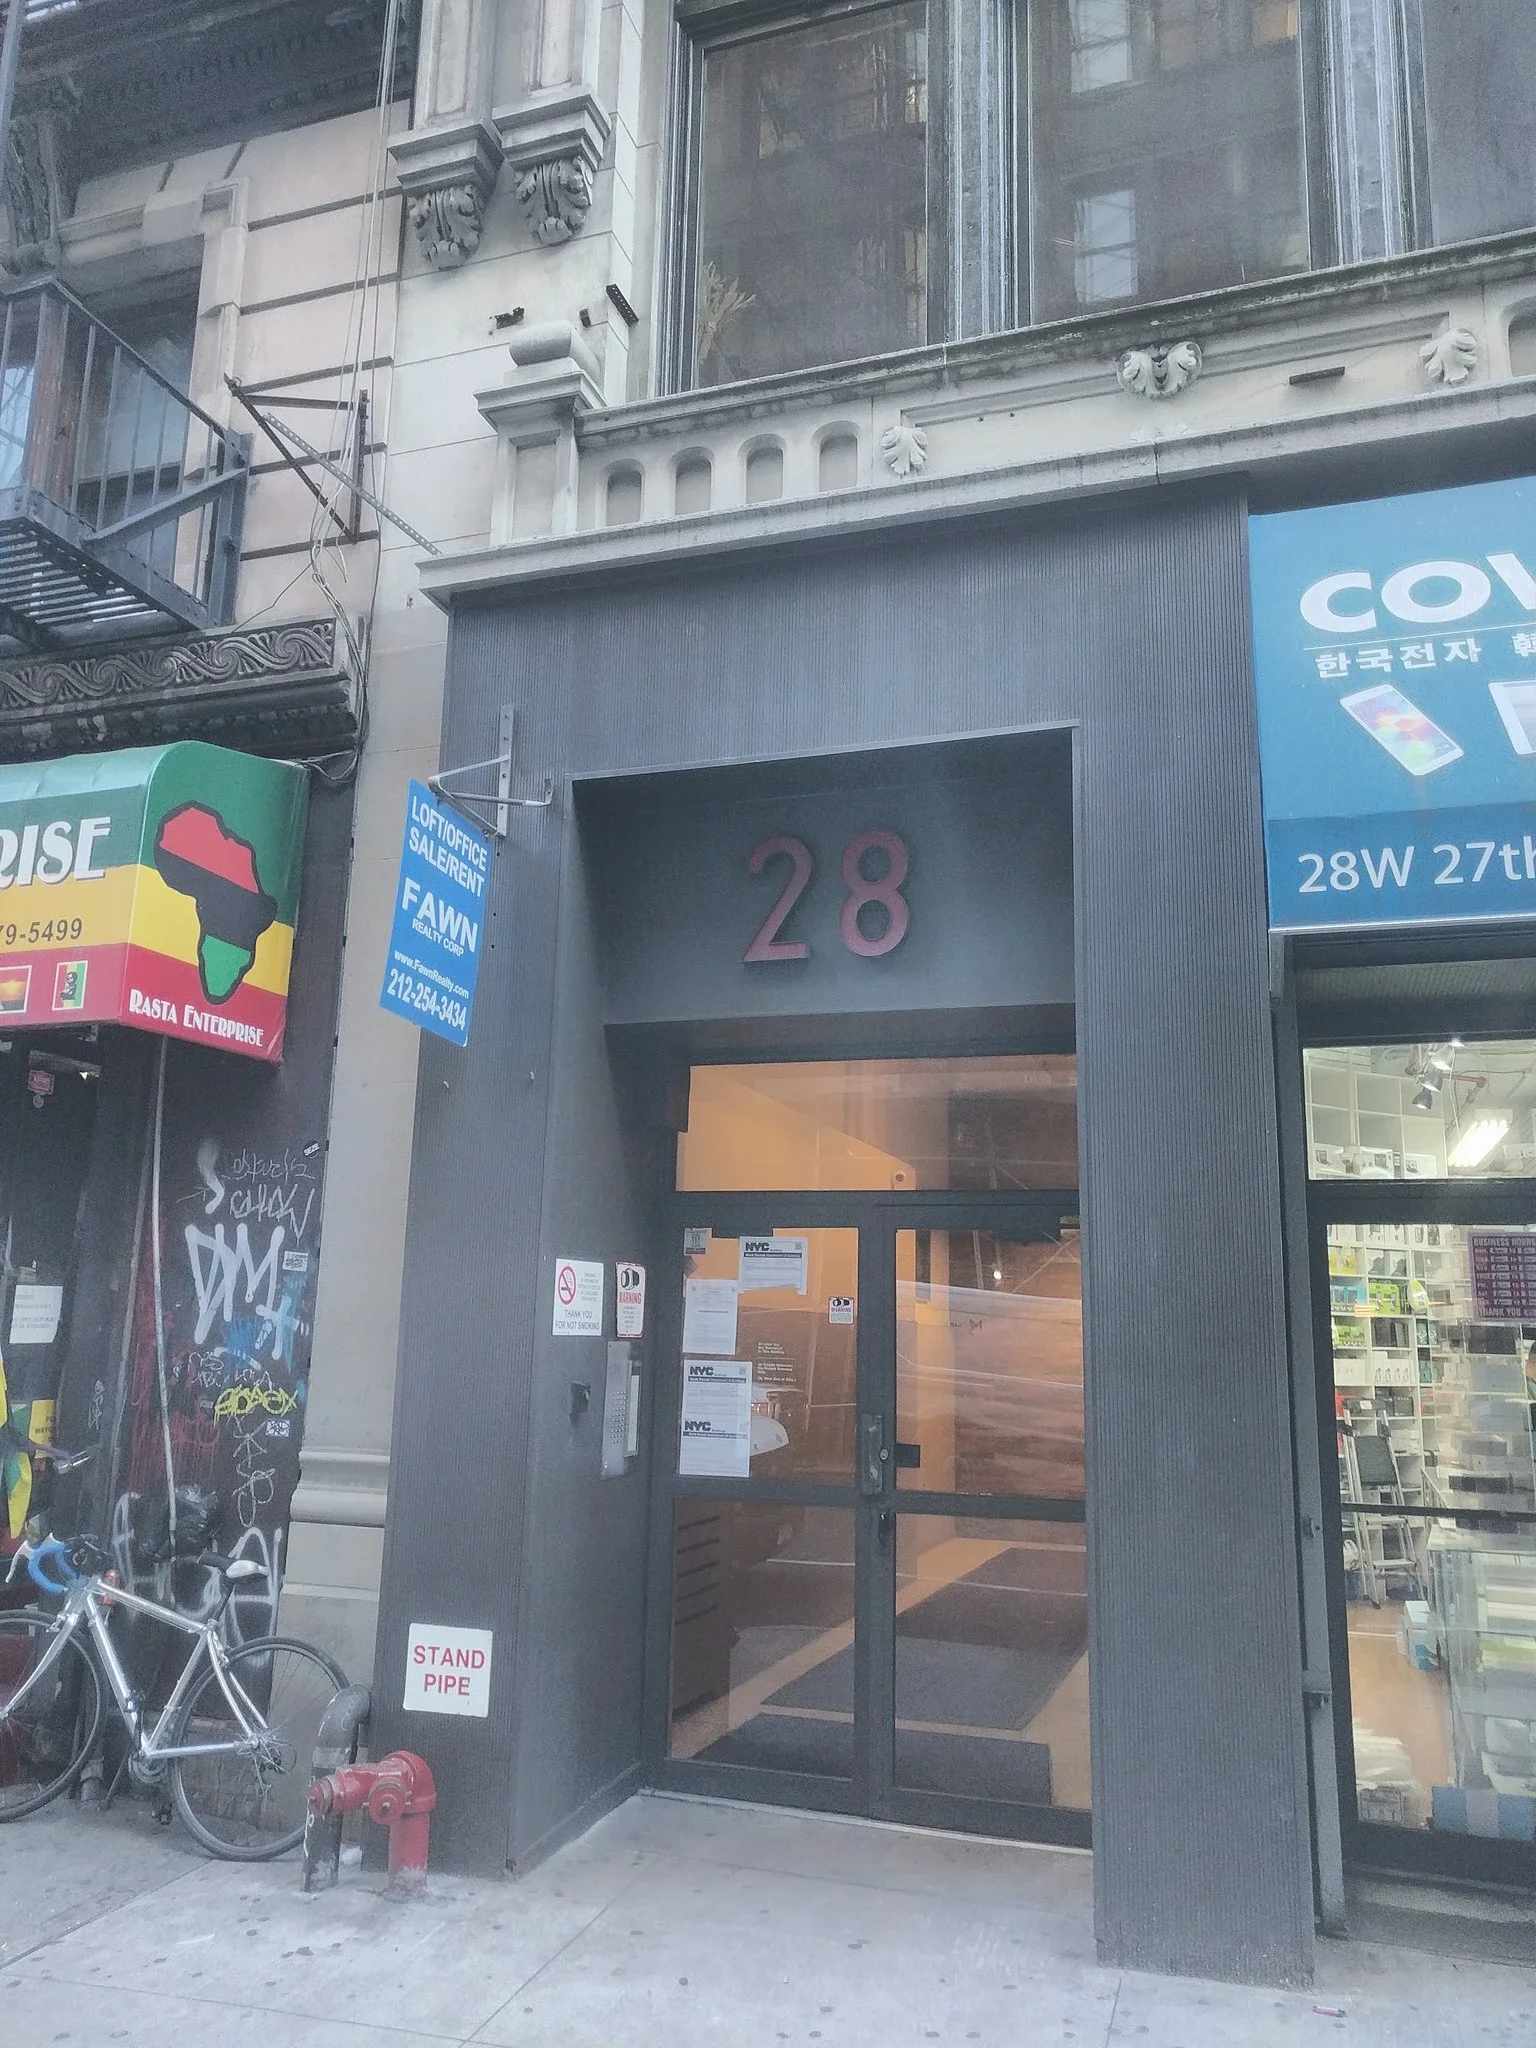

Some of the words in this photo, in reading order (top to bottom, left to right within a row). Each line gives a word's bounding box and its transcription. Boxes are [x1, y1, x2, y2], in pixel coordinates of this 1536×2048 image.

[1315, 638, 1481, 679] 한국전자
[411, 796, 487, 871] LOFT/OFFICE
[409, 827, 484, 897] SALE/RENT
[1298, 845, 1415, 893] 28W
[742, 828, 909, 962] 28
[402, 876, 478, 953] FAWN
[0, 917, 83, 945] 9-5499
[412, 918, 443, 944] REALTY
[443, 938, 465, 957] CORP
[387, 968, 467, 1031] 212-254-3434
[745, 1242, 770, 1252] NYC
[619, 1291, 641, 1304] WARNING
[555, 1320, 566, 1329] FOR
[567, 1321, 578, 1330] NOT
[578, 1321, 600, 1331] SMOKING
[565, 1309, 581, 1319] THANK
[582, 1310, 593, 1320] YOU
[689, 1366, 714, 1376] NYC
[684, 1420, 712, 1432] NYC
[413, 1644, 485, 1670] STAND
[423, 1673, 471, 1697] PIPE
